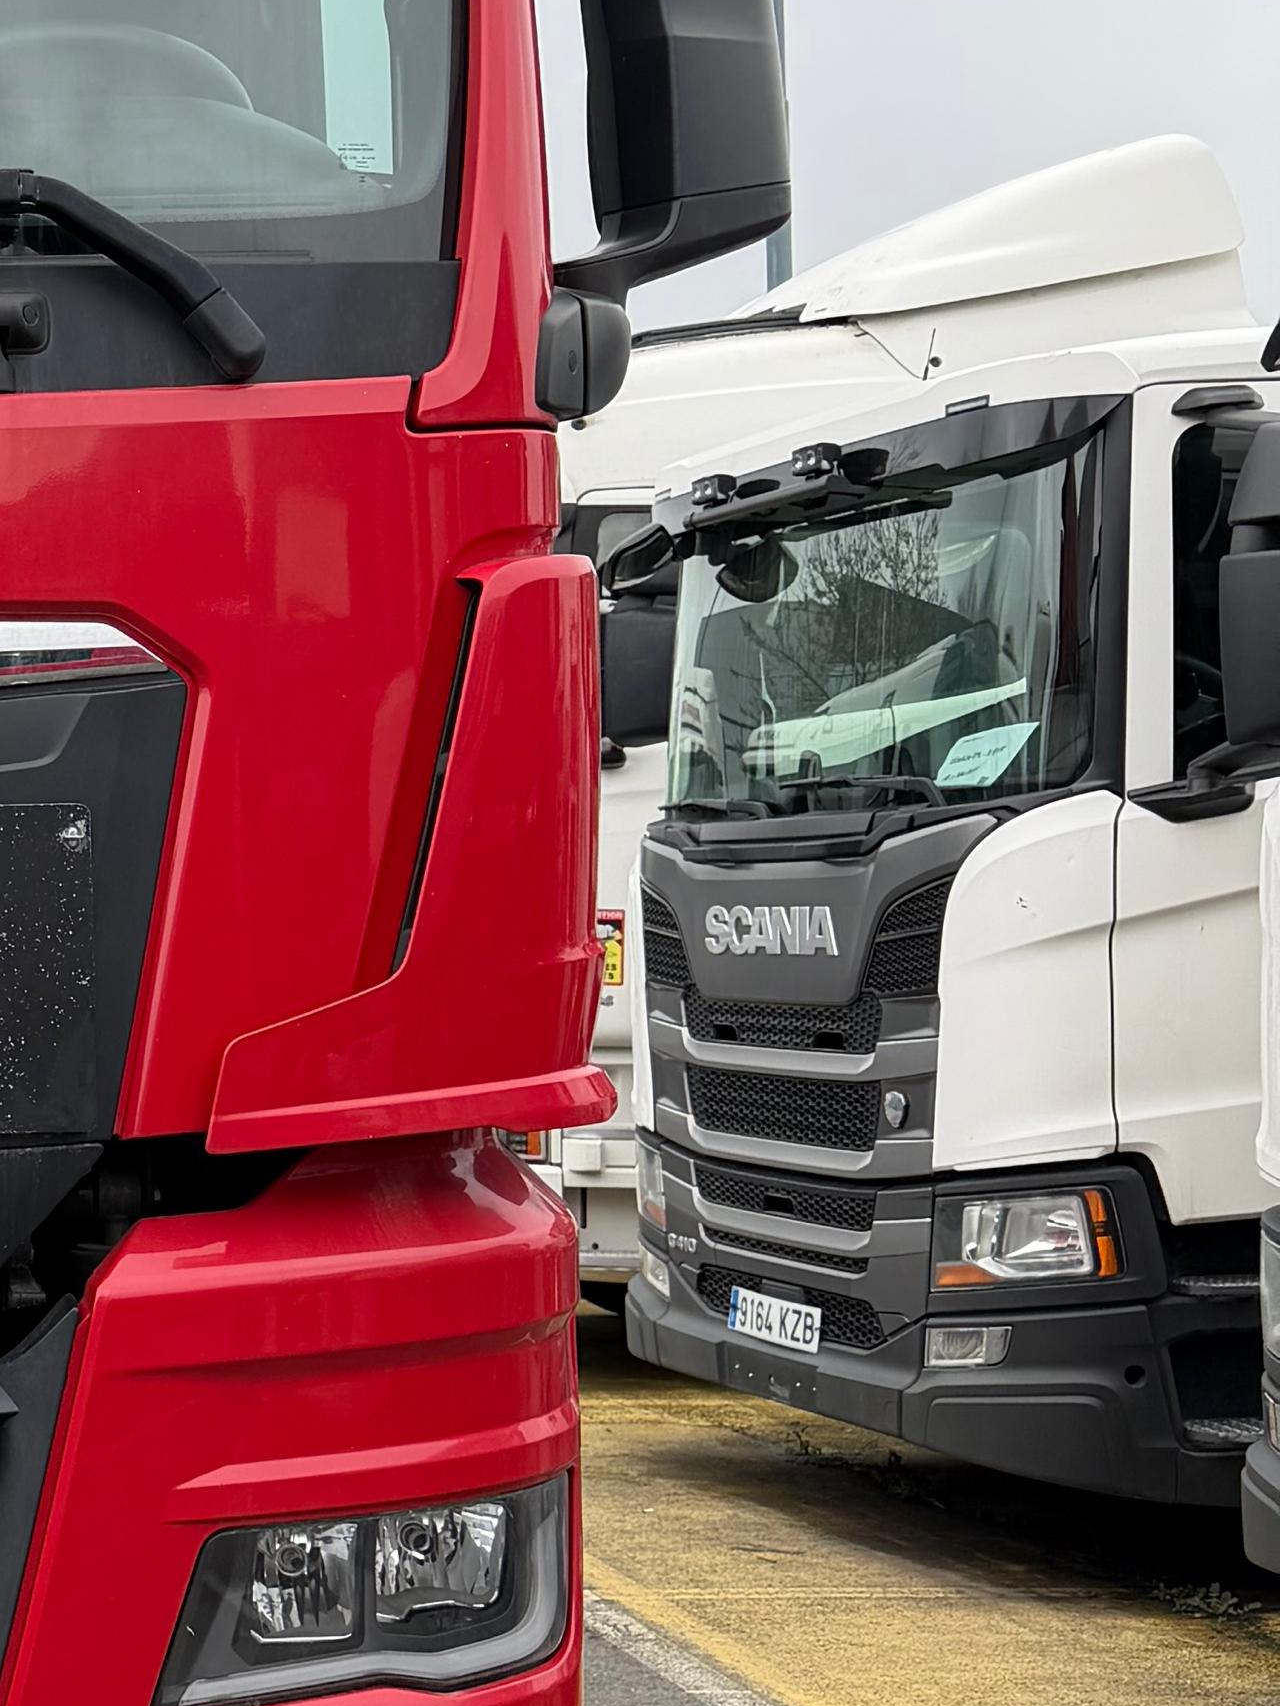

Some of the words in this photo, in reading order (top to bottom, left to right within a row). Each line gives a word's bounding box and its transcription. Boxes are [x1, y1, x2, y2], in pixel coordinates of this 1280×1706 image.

[705, 905, 839, 956] SCANIA
[739, 1296, 773, 1336] 9164
[778, 1305, 815, 1346] KZB
